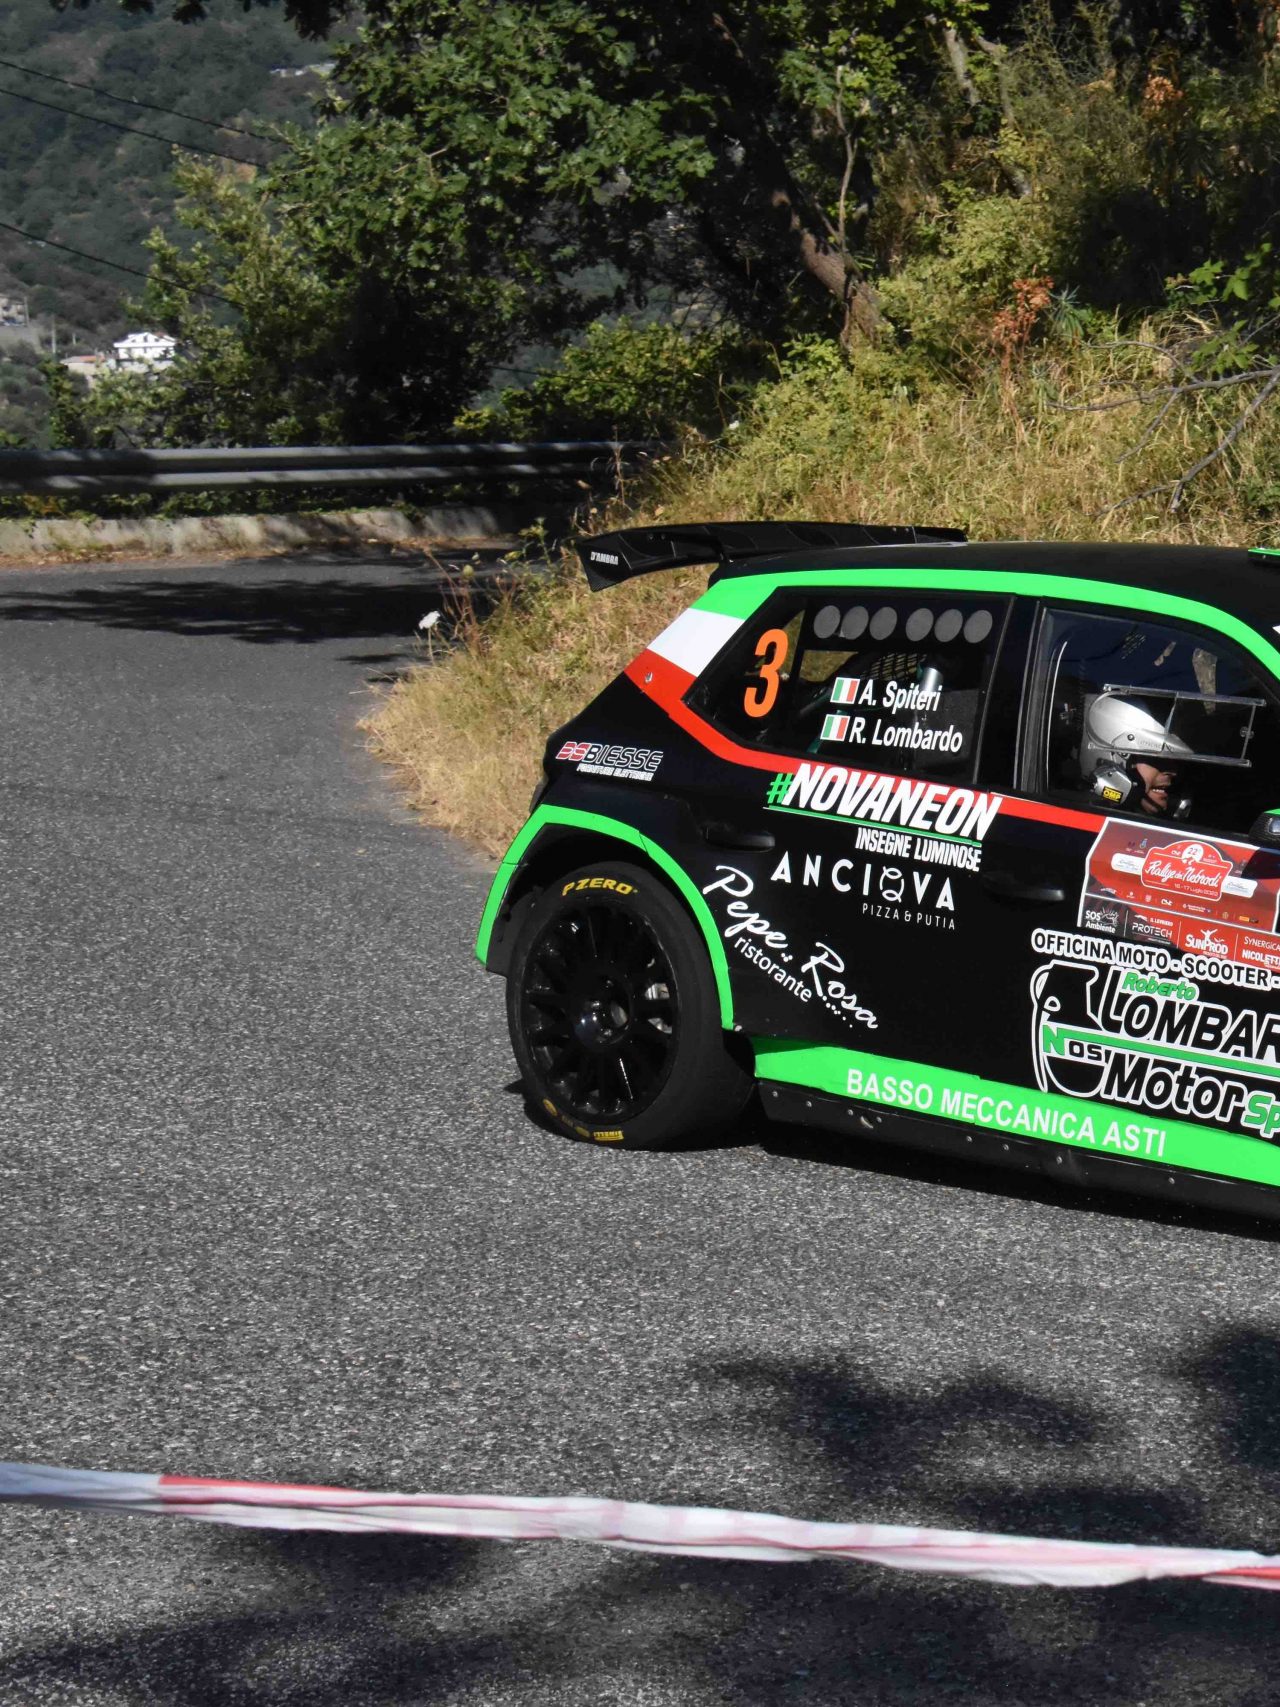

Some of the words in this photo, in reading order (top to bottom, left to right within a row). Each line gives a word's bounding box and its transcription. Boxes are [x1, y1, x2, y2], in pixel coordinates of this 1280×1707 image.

[743, 629, 788, 718] 3
[858, 681, 877, 705] A.
[882, 681, 943, 713] Spiteri
[849, 720, 868, 743] R.
[872, 721, 963, 754] Lombardo
[581, 743, 664, 772] BIESSE
[766, 762, 1003, 841] #NOVANEON
[1103, 789, 1122, 801] OMP
[855, 828, 914, 857] INSEGNE
[914, 839, 982, 872] LUMINOSE
[576, 878, 633, 895] ZERO
[862, 903, 900, 921] PIZZA
[904, 909, 912, 919] &
[917, 911, 956, 931] PUTIA
[1085, 910, 1101, 921] SOS
[1085, 921, 1116, 934] Ambiente
[1131, 922, 1173, 938] PROTECH
[703, 865, 788, 949] Pepe
[801, 942, 878, 1029] Rosa
[1034, 932, 1113, 963] OFFICINA
[1118, 946, 1168, 972] MOTO
[1184, 957, 1268, 988] SCOOTER
[734, 935, 812, 1003] ristorante
[1122, 971, 1197, 1000] Roberto
[1106, 1053, 1245, 1118] Motor
[846, 1067, 933, 1107] BASSO
[939, 1088, 1097, 1145] MECCANICA
[1103, 1113, 1167, 1158] ASTI
